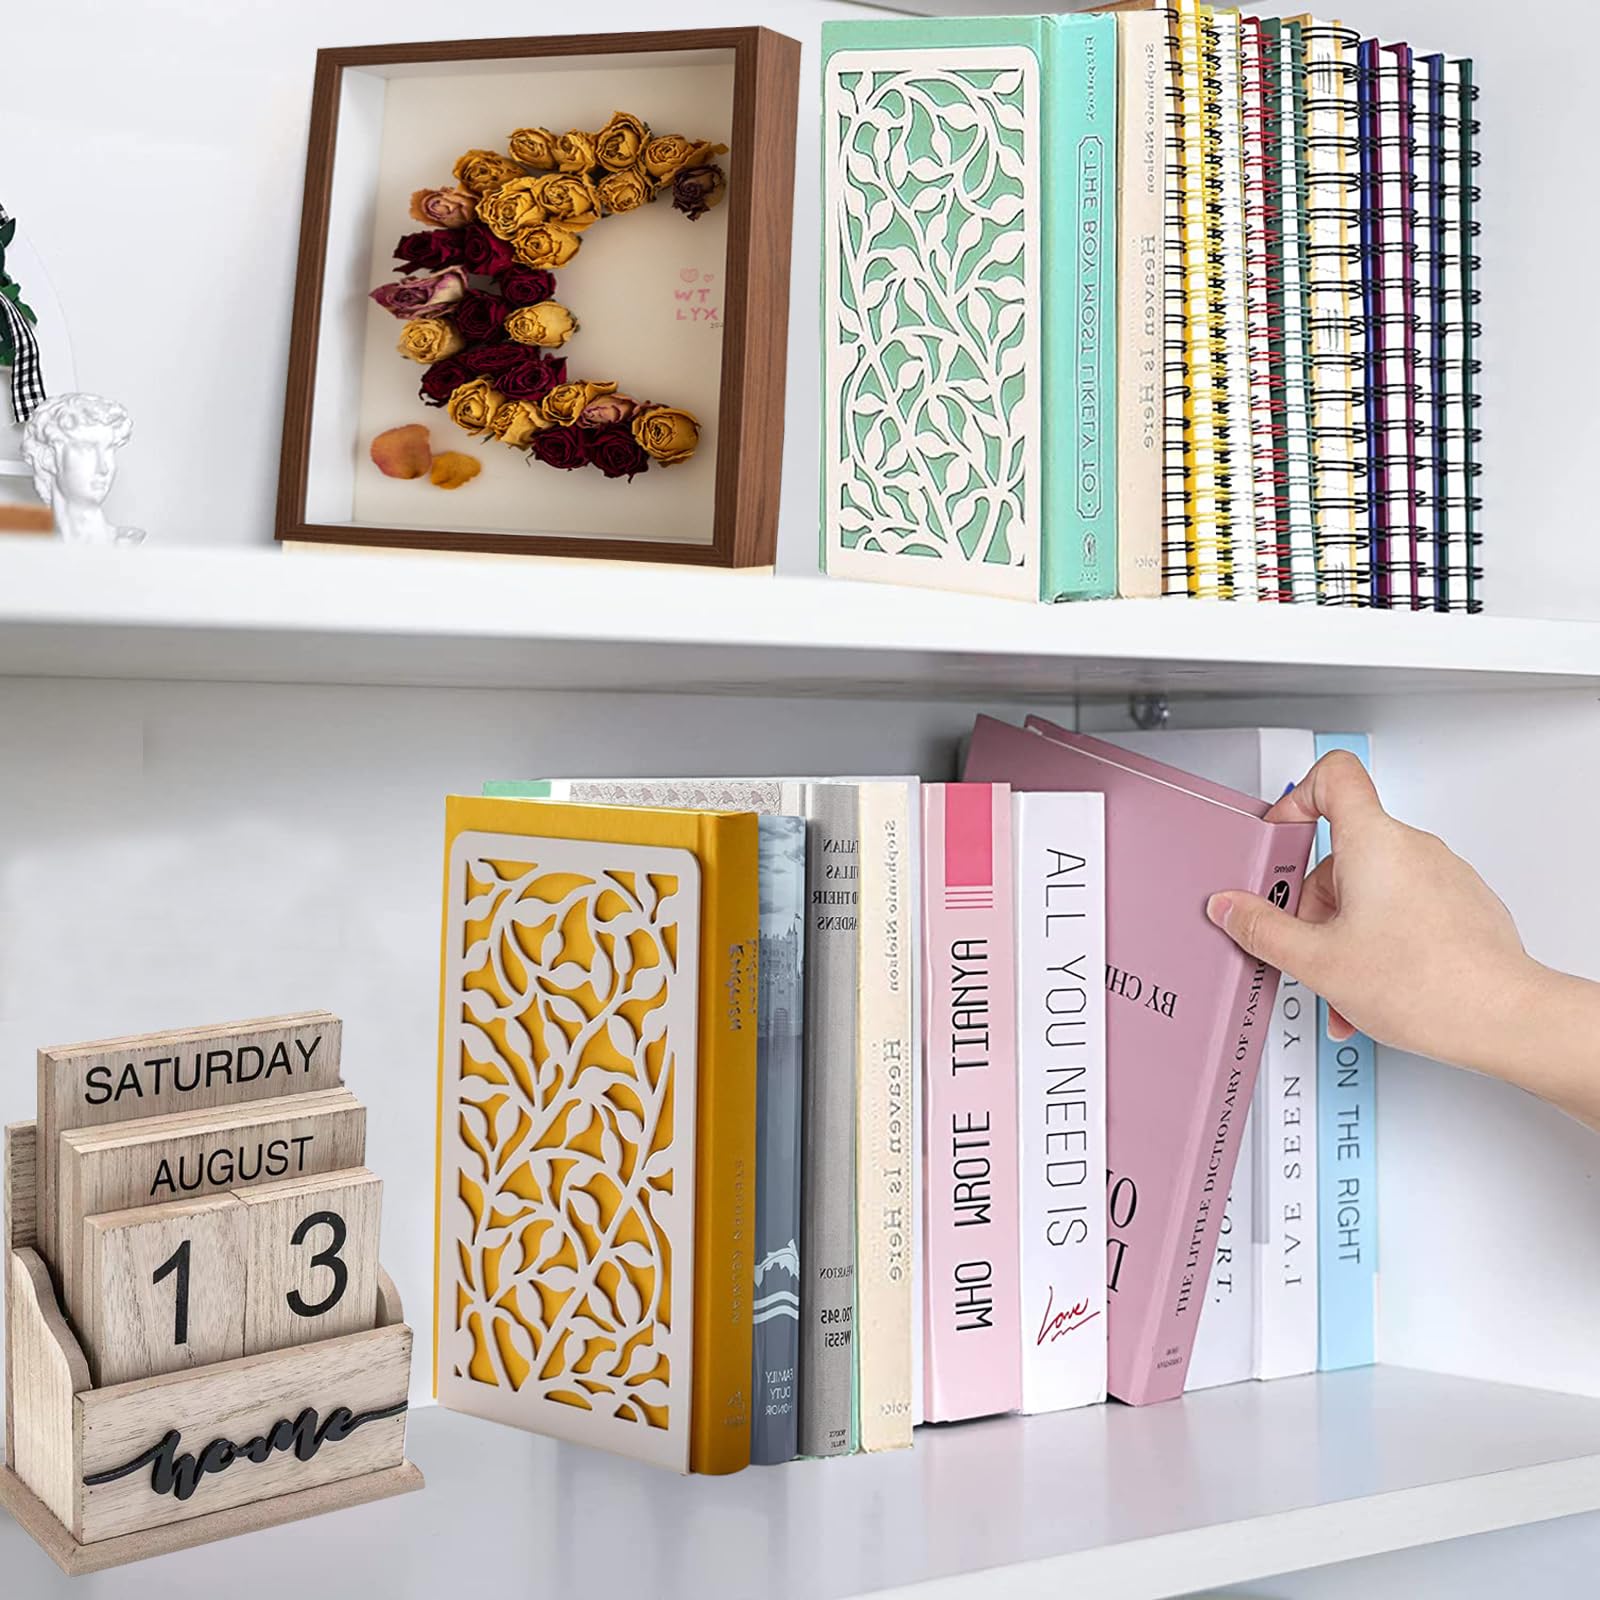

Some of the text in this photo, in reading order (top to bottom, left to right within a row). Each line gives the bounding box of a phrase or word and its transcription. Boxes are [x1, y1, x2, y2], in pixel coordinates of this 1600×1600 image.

[675, 307, 719, 321] LYX
[1045, 848, 1088, 1246] ALL YOU NEED IS
[1144, 983, 1179, 1019] BY
[84, 1036, 323, 1106] SATURDAY
[150, 1136, 314, 1197] AUGUST
[951, 939, 993, 1331] WHO WROTE TIANYA
[1283, 1075, 1302, 1180] SEEN
[1336, 1046, 1361, 1265] ON THE RIGHT
[1175, 1273, 1195, 1317] THE
[1185, 1198, 1212, 1268] LITTLE
[1203, 1068, 1243, 1193] DICTIONARY
[1234, 1033, 1251, 1062] OF
[1284, 1202, 1302, 1287] I'VE
[1036, 1285, 1090, 1346] Love
[83, 1400, 409, 1501] home
